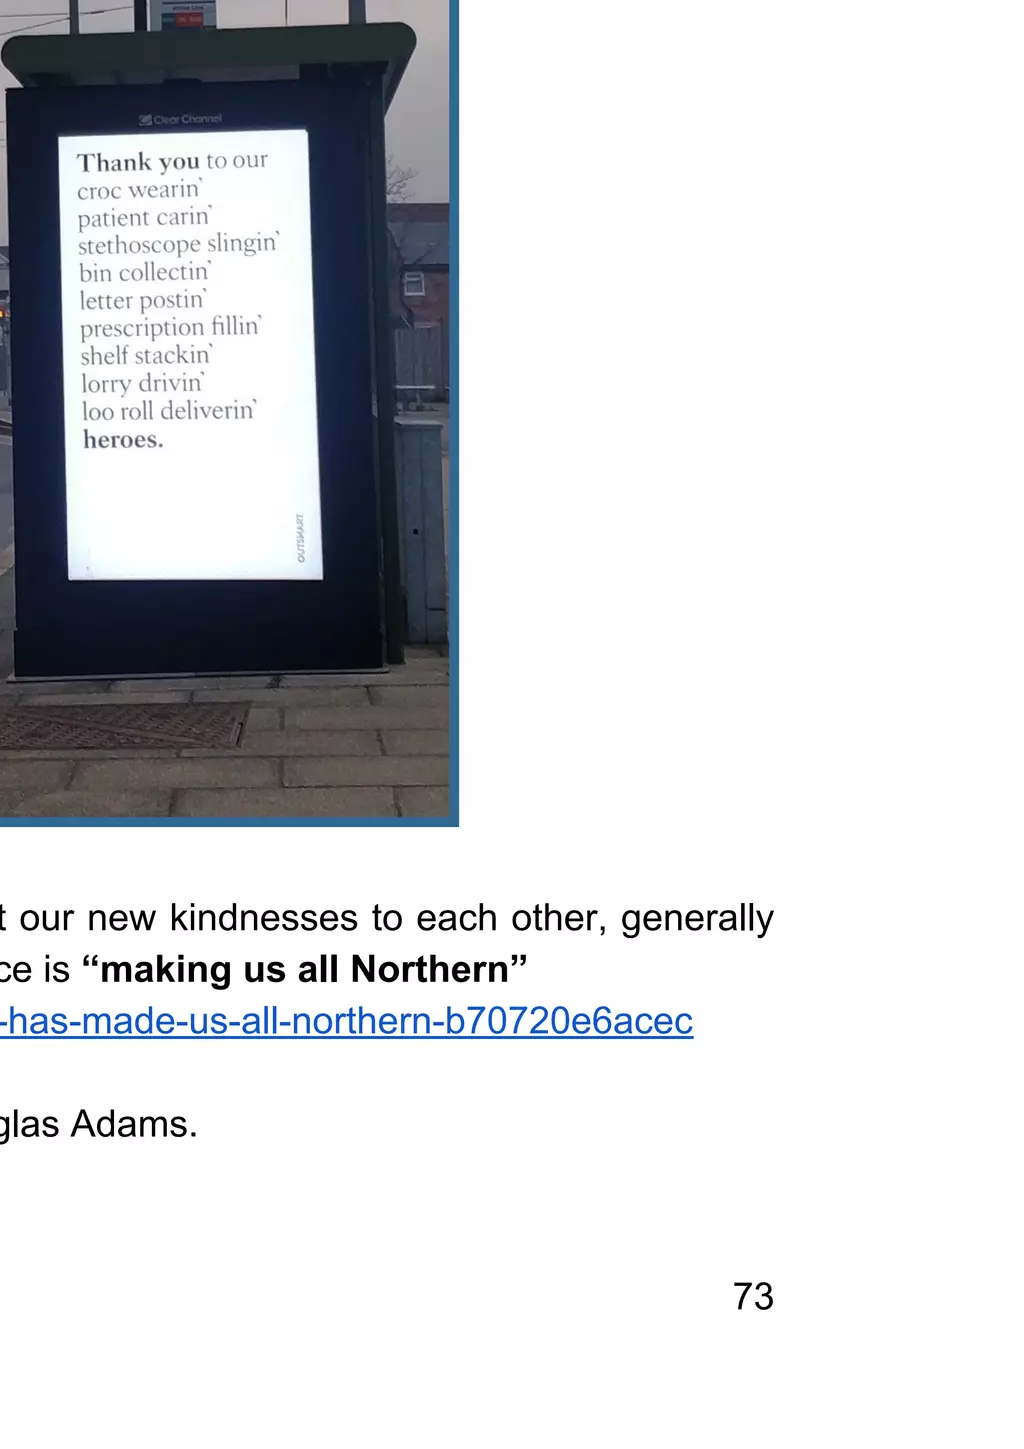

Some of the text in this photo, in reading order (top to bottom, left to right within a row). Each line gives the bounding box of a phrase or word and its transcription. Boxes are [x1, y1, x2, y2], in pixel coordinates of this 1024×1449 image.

[154, 113, 222, 125] Clear Channel
[76, 151, 268, 175] Thank you to our
[78, 186, 121, 200] croc
[78, 208, 149, 233] patient
[79, 235, 200, 258] stethoscope
[80, 263, 111, 283] bin
[81, 290, 133, 309] letter
[81, 317, 204, 343] prescription
[82, 345, 129, 365] shelf
[82, 373, 131, 397] lorry
[83, 401, 114, 421] loo
[121, 400, 153, 420] roll
[84, 429, 163, 449] heroes.
[20, 910, 75, 931] our
[89, 910, 156, 931] new
[172, 903, 357, 931] kindnesses
[372, 904, 402, 931] to
[417, 903, 496, 931] each
[512, 903, 605, 936] other,
[622, 903, 774, 938] generally
[46, 954, 69, 982] is
[245, 962, 285, 983] us
[299, 954, 337, 982] all
[71, 1109, 196, 1137] Adams.
[734, 1282, 773, 1310] 73
